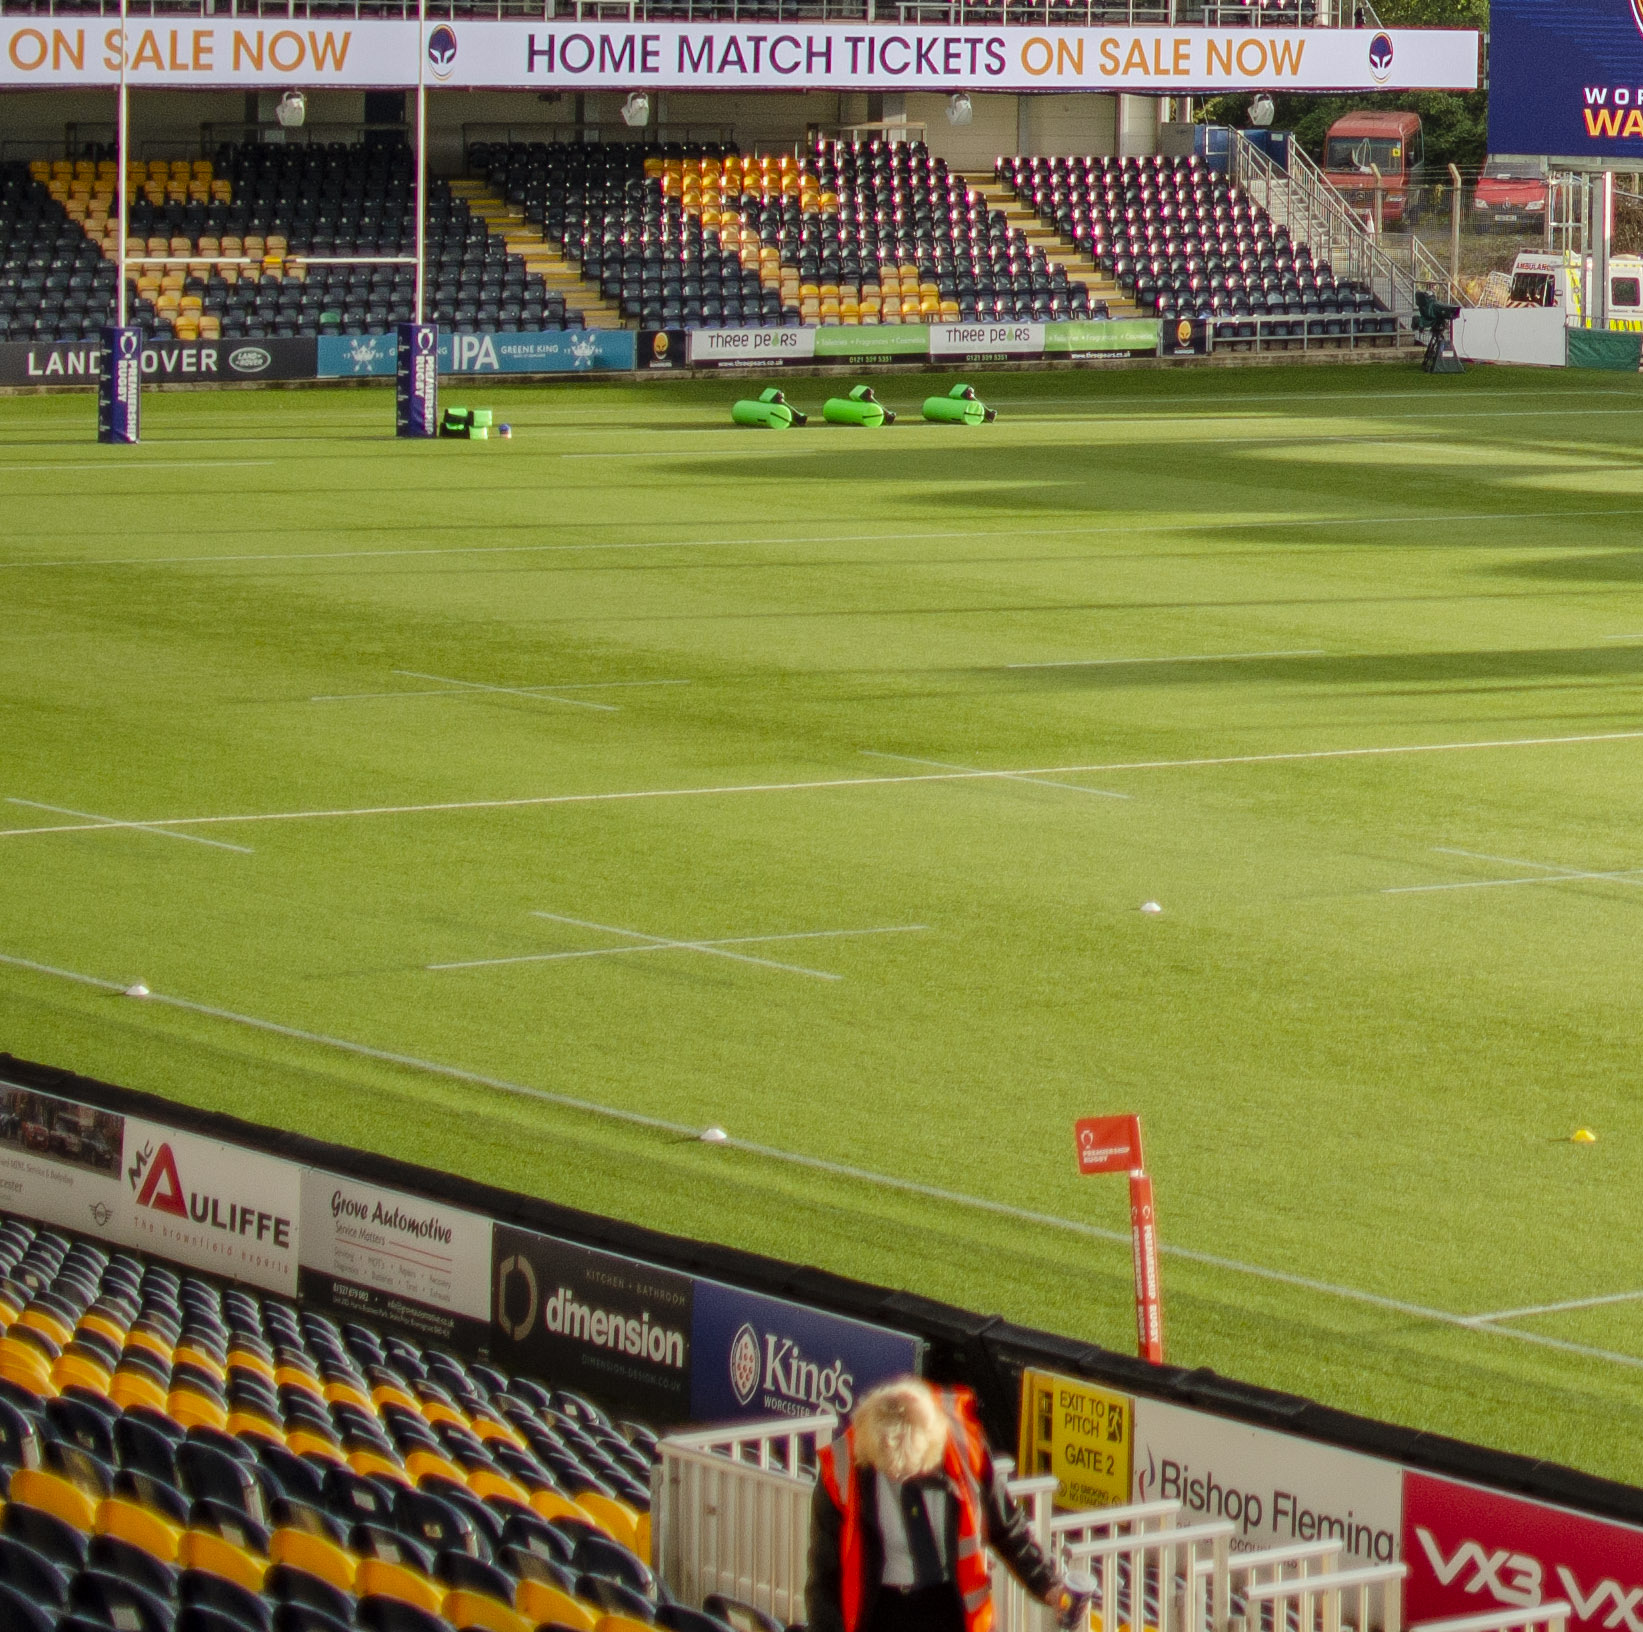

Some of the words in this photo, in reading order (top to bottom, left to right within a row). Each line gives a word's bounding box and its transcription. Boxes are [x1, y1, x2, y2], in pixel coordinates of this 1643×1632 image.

[8, 28, 85, 71] ON
[103, 28, 214, 71] SALE
[232, 29, 352, 72] NOW
[527, 33, 660, 73] HOME
[678, 34, 832, 75] MATCH
[844, 35, 1006, 76] TICKETS
[1021, 37, 1083, 76] ON
[1099, 37, 1190, 76] SALE
[1206, 37, 1306, 77] NOW
[141, 349, 218, 372] OVER
[453, 335, 499, 370] IPA
[501, 345, 534, 354] GREENE
[536, 344, 559, 354] KING
[117, 359, 127, 403] RUGBY
[414, 355, 425, 398] RUGBY
[424, 355, 434, 435] PREMIERSHIP
[127, 359, 138, 440] PREMIERSHIP
[331, 1190, 369, 1219] Grove
[371, 1201, 453, 1244] Automotive
[1144, 1224, 1156, 1300] PREMIERSHIP
[585, 1269, 625, 1289] KITCHEN
[636, 1282, 686, 1306] BATHROOM
[546, 1287, 683, 1368] dimension
[1149, 1304, 1159, 1343] RUGBY
[763, 1333, 853, 1416] King's
[1060, 1390, 1086, 1414] EXIT
[1089, 1399, 1105, 1418] TO
[1064, 1413, 1100, 1438] PITCH
[1065, 1443, 1102, 1473] GATE
[1106, 1455, 1114, 1476] 2
[1161, 1459, 1263, 1536] Bishop
[1272, 1490, 1394, 1564] Fleming
[1415, 1527, 1542, 1608] VX3
